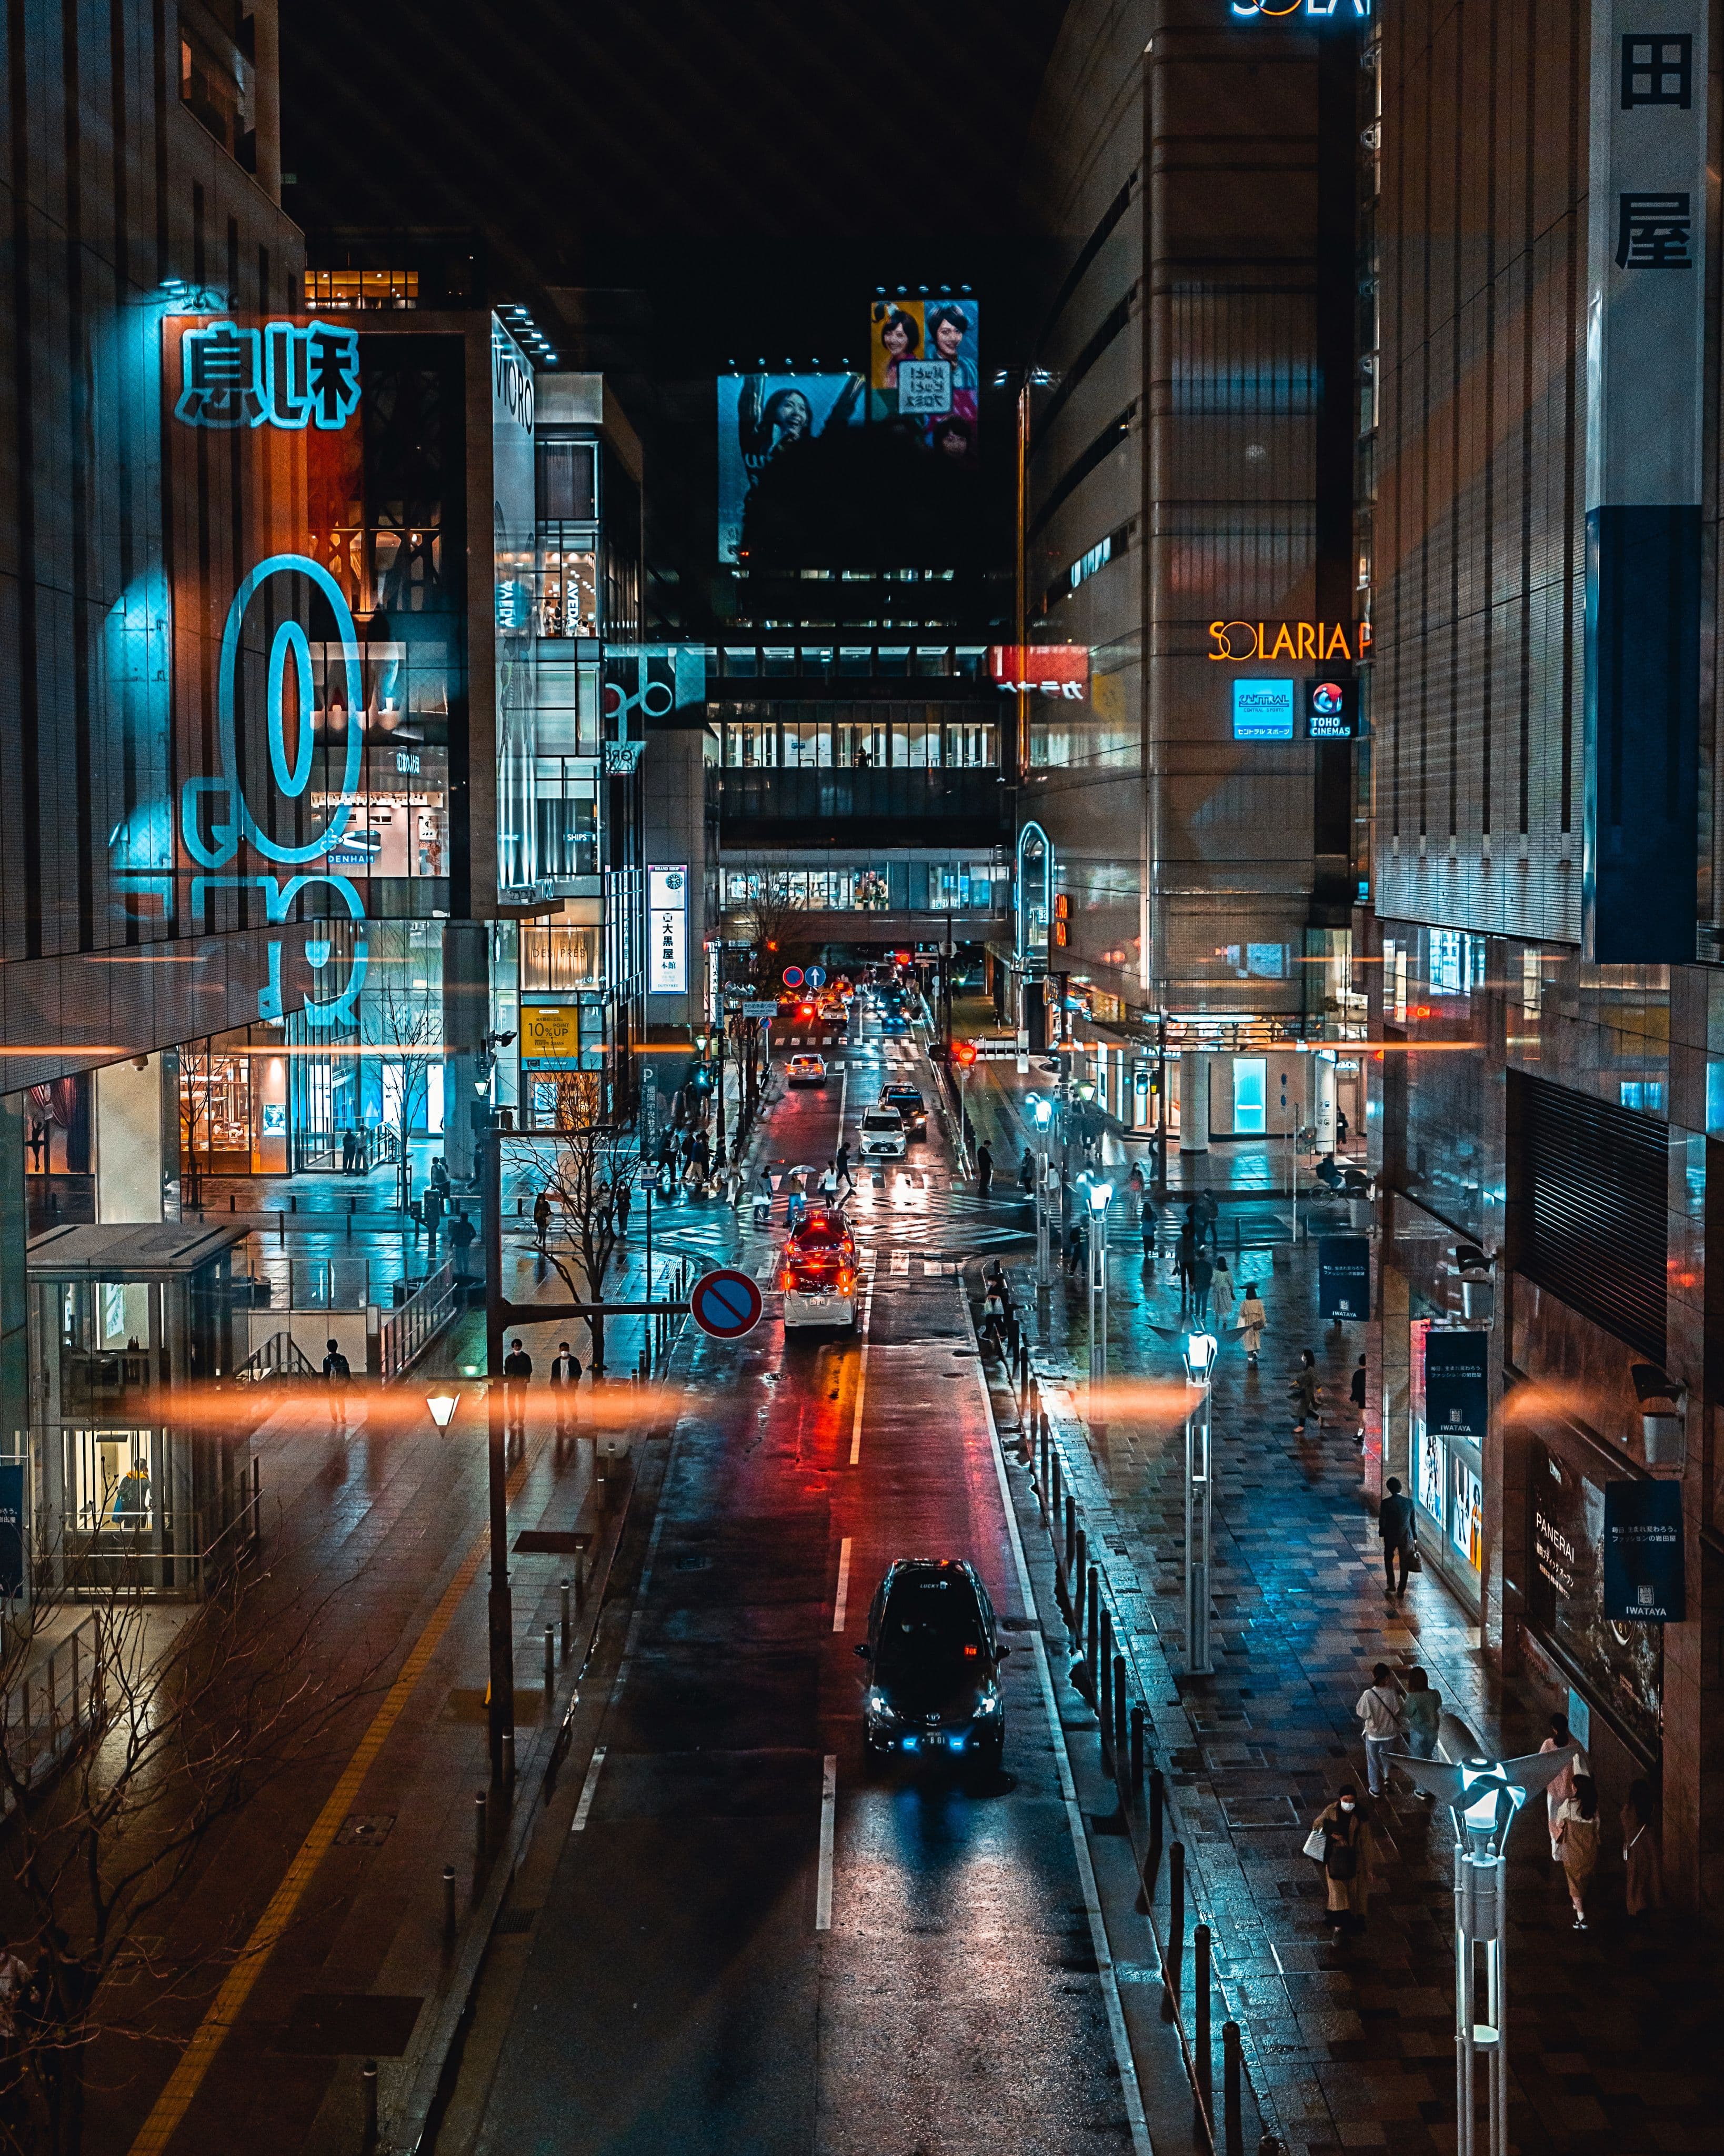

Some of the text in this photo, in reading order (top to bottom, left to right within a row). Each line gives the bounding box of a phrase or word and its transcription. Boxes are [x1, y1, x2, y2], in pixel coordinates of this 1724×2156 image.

[1615, 33, 1692, 270] 田屋
[495, 336, 533, 435] VIORO
[567, 580, 578, 628] AVEDA
[1208, 621, 1351, 661] SOLARIA
[1312, 717, 1339, 726] TOHO
[663, 923, 674, 959] 大黒屋
[528, 1023, 552, 1036] 10%
[644, 1069, 653, 1083] P
[1536, 1512, 1574, 1564] PANERAI
[1626, 1606, 1667, 1616] IWATAYA
